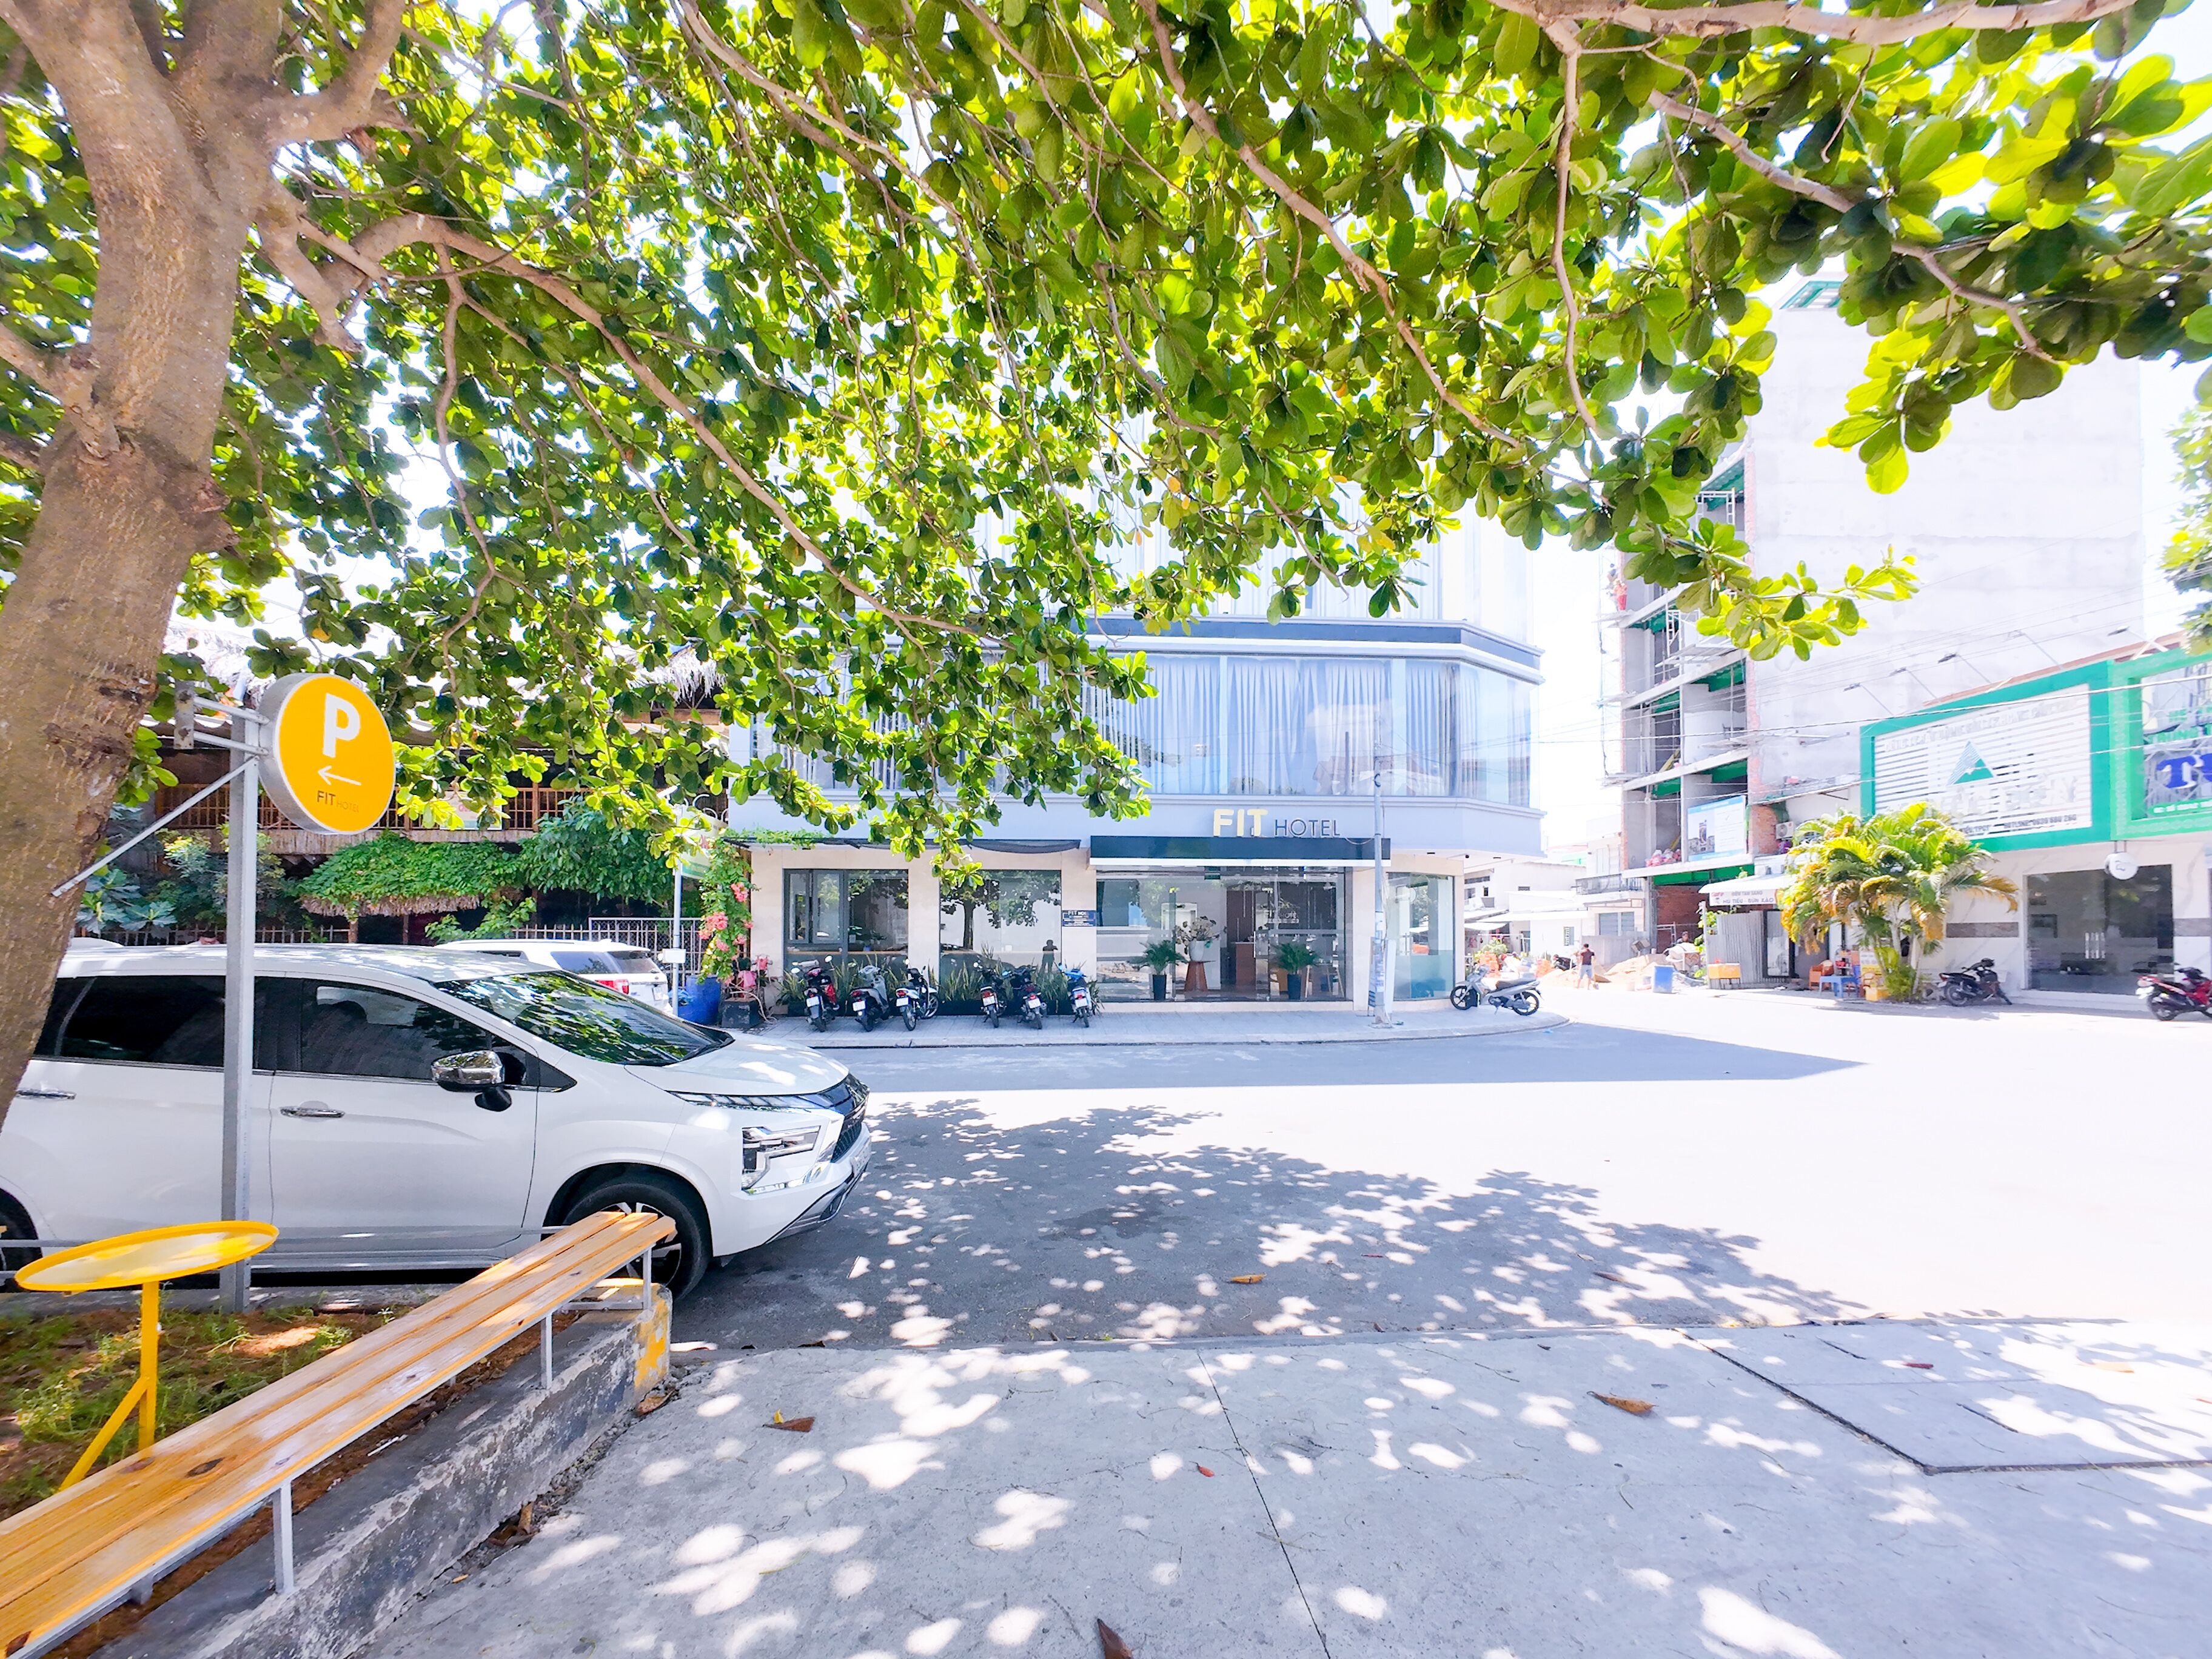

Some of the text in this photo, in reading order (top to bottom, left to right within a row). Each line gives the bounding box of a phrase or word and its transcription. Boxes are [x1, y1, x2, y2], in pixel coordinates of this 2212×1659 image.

[322, 692, 361, 758] P
[317, 790, 360, 813] FIT HOTEL
[1213, 808, 1341, 837] FIT HOTEL
